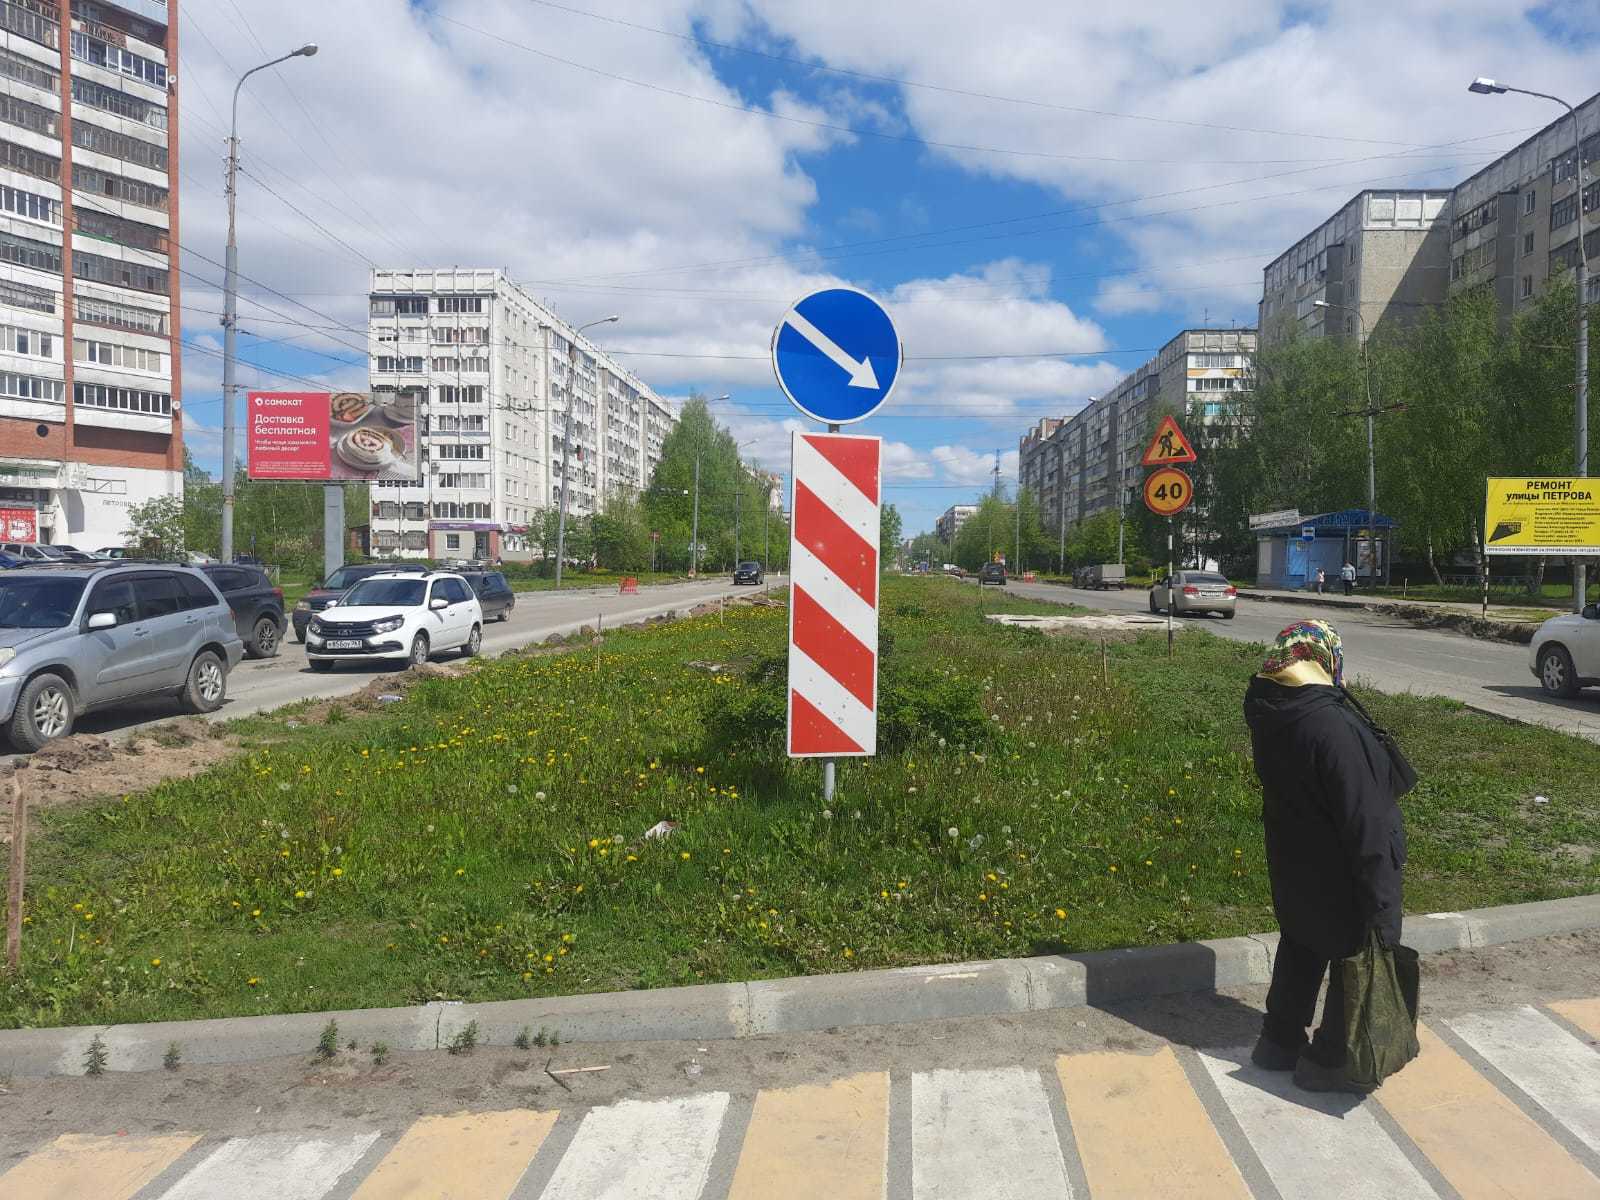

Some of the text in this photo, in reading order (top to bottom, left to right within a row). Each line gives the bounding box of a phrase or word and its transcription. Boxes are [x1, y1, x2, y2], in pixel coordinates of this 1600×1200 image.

[264, 398, 303, 406] самокат
[254, 414, 304, 424] Доставка
[254, 425, 316, 435] бесплатная
[1526, 481, 1573, 490] РЕМОНТ
[1154, 482, 1183, 500] 40
[1506, 491, 1592, 501] улицы ПЕТРОВА
